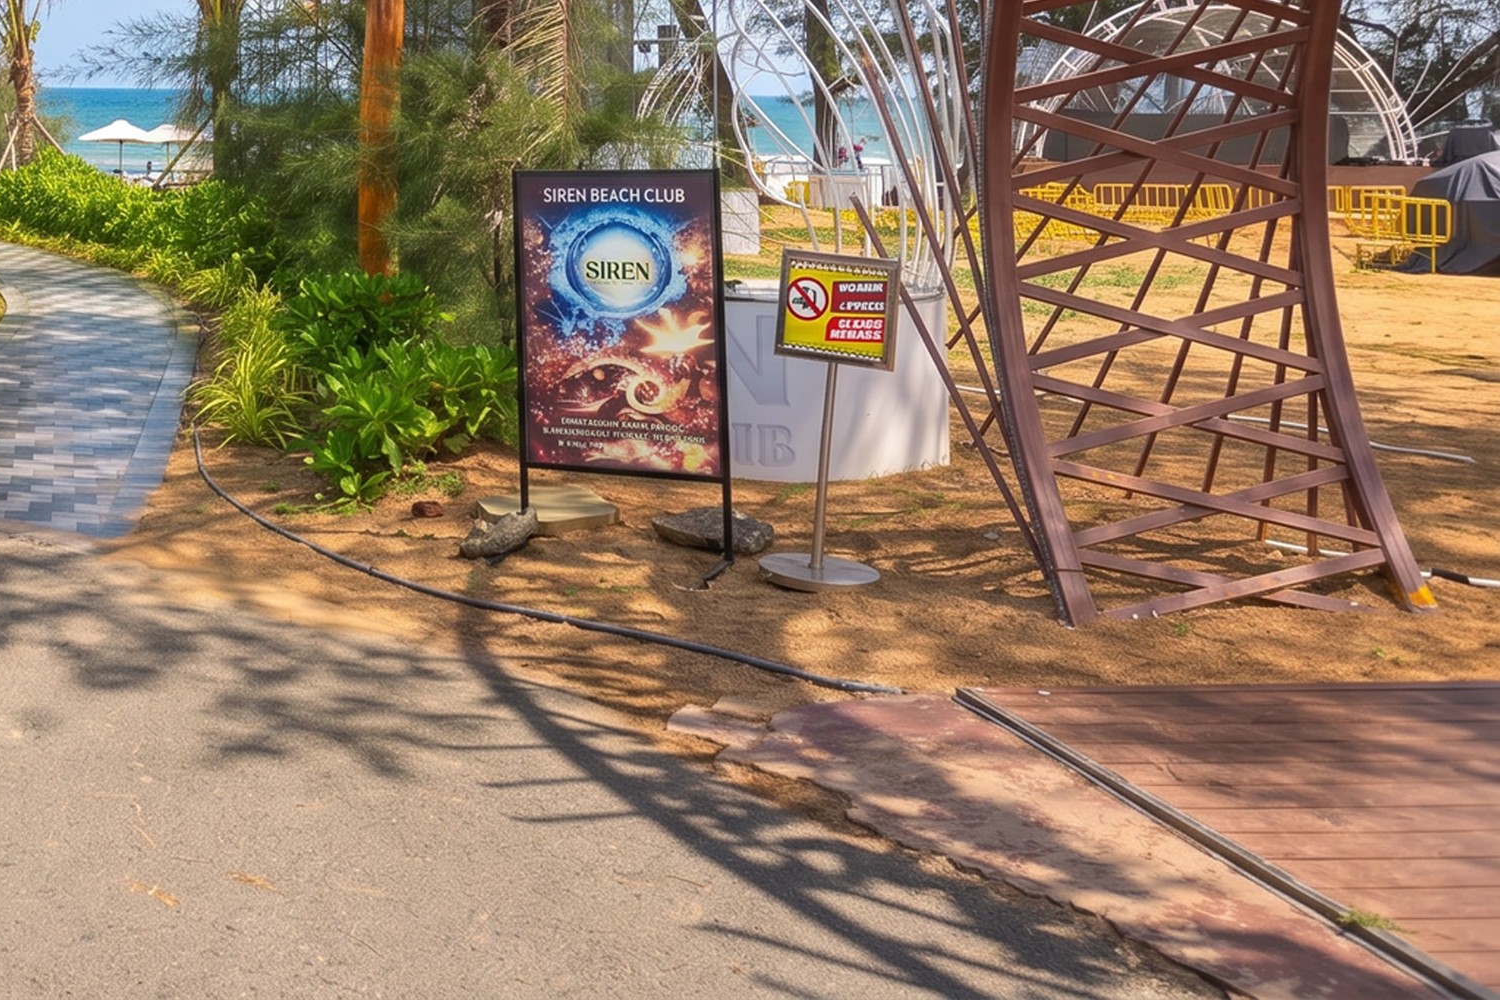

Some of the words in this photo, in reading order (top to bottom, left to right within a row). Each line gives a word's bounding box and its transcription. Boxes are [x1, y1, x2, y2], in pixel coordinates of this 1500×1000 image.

[543, 187, 587, 203] SIREN
[590, 187, 640, 203] BEACH
[644, 188, 686, 203] CLUB
[585, 260, 649, 281] SIREN
